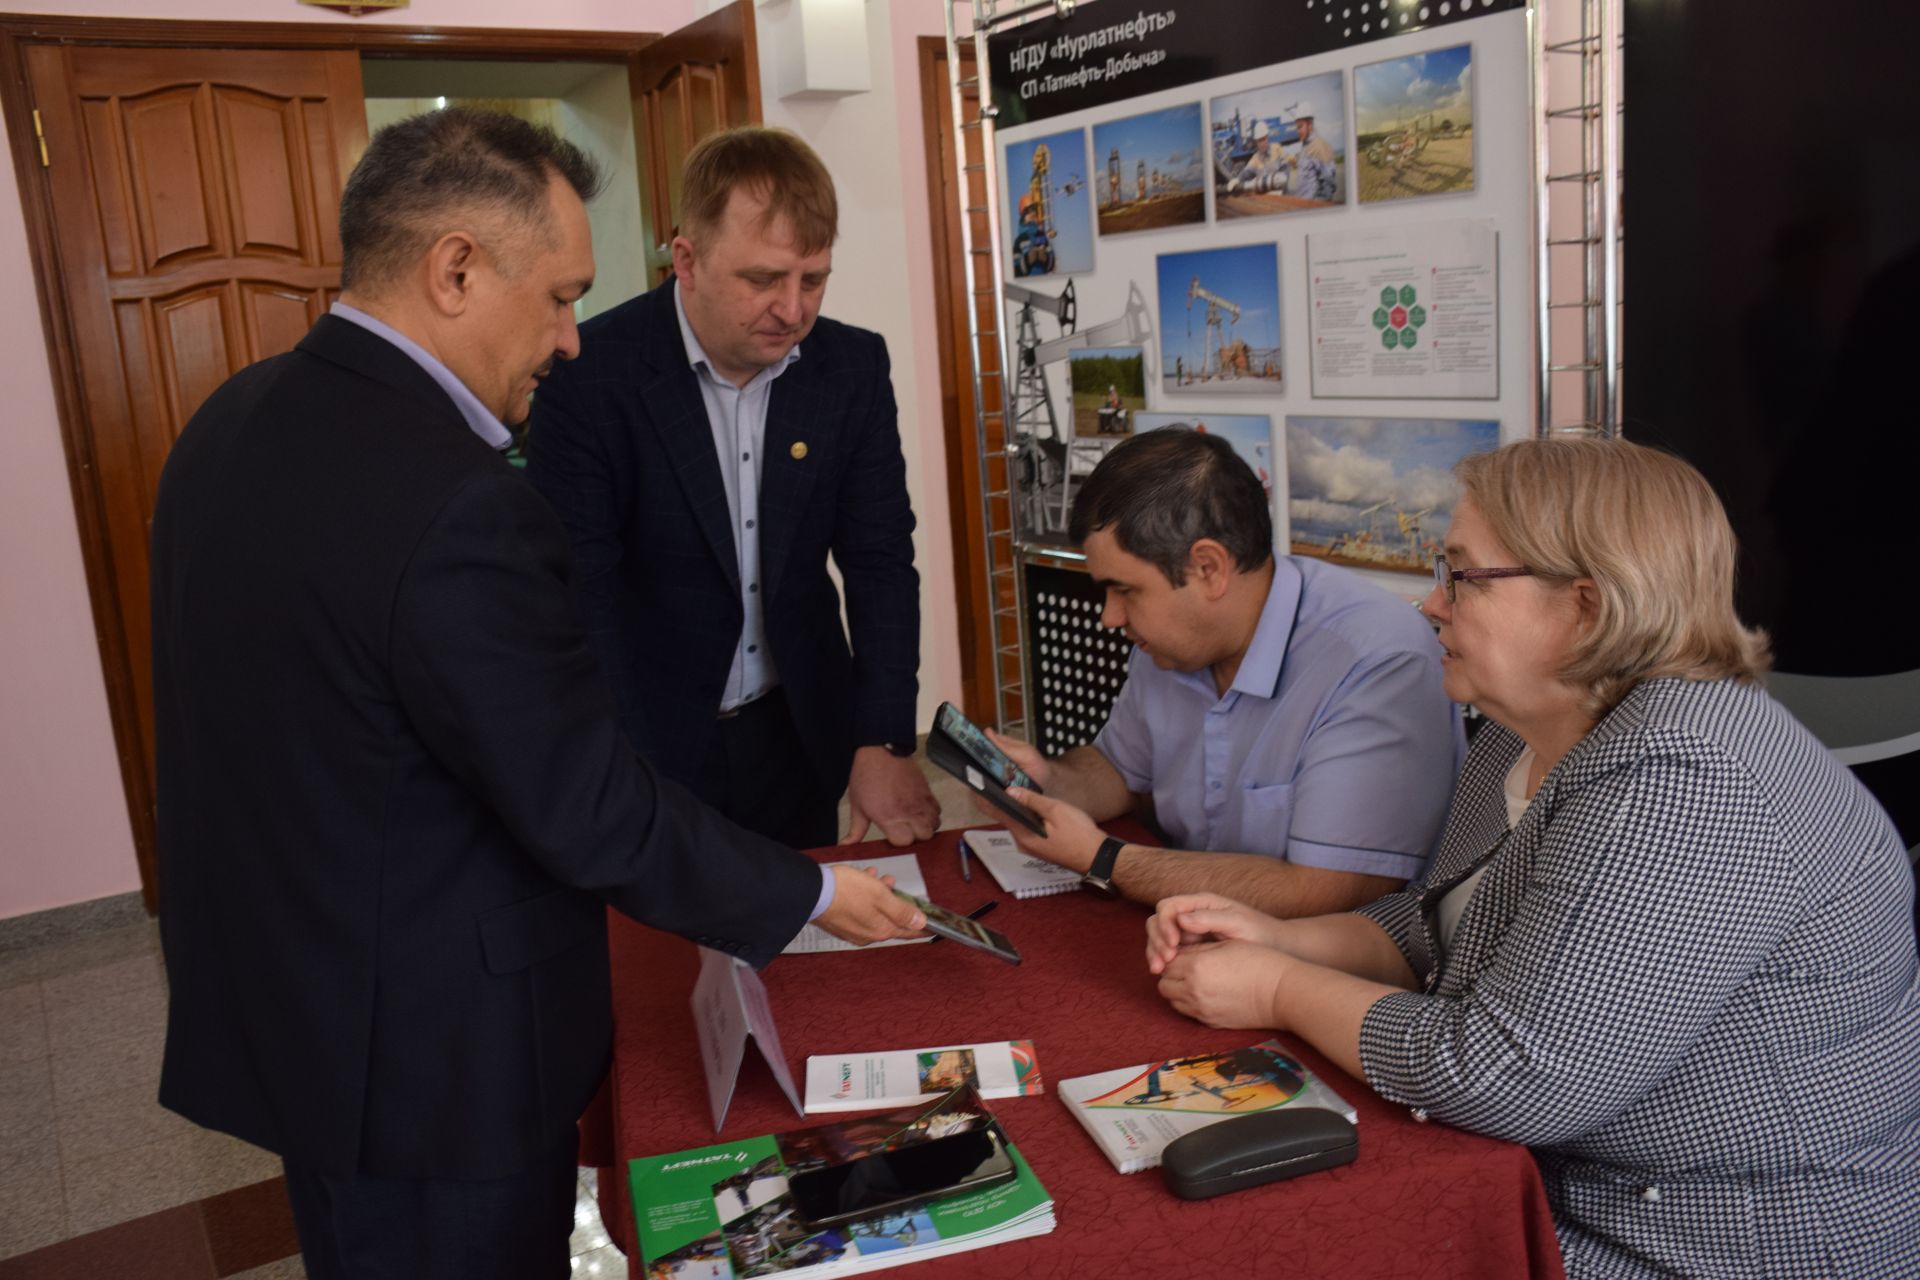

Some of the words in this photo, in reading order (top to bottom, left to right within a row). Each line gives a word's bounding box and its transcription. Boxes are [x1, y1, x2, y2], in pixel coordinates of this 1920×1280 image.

[1010, 41, 1048, 73] НГДУ
[1050, 10, 1177, 62] «Нурлатнефть»
[1020, 79, 1038, 99] СП
[1039, 49, 1167, 93] «Татнефть-Добыча»
